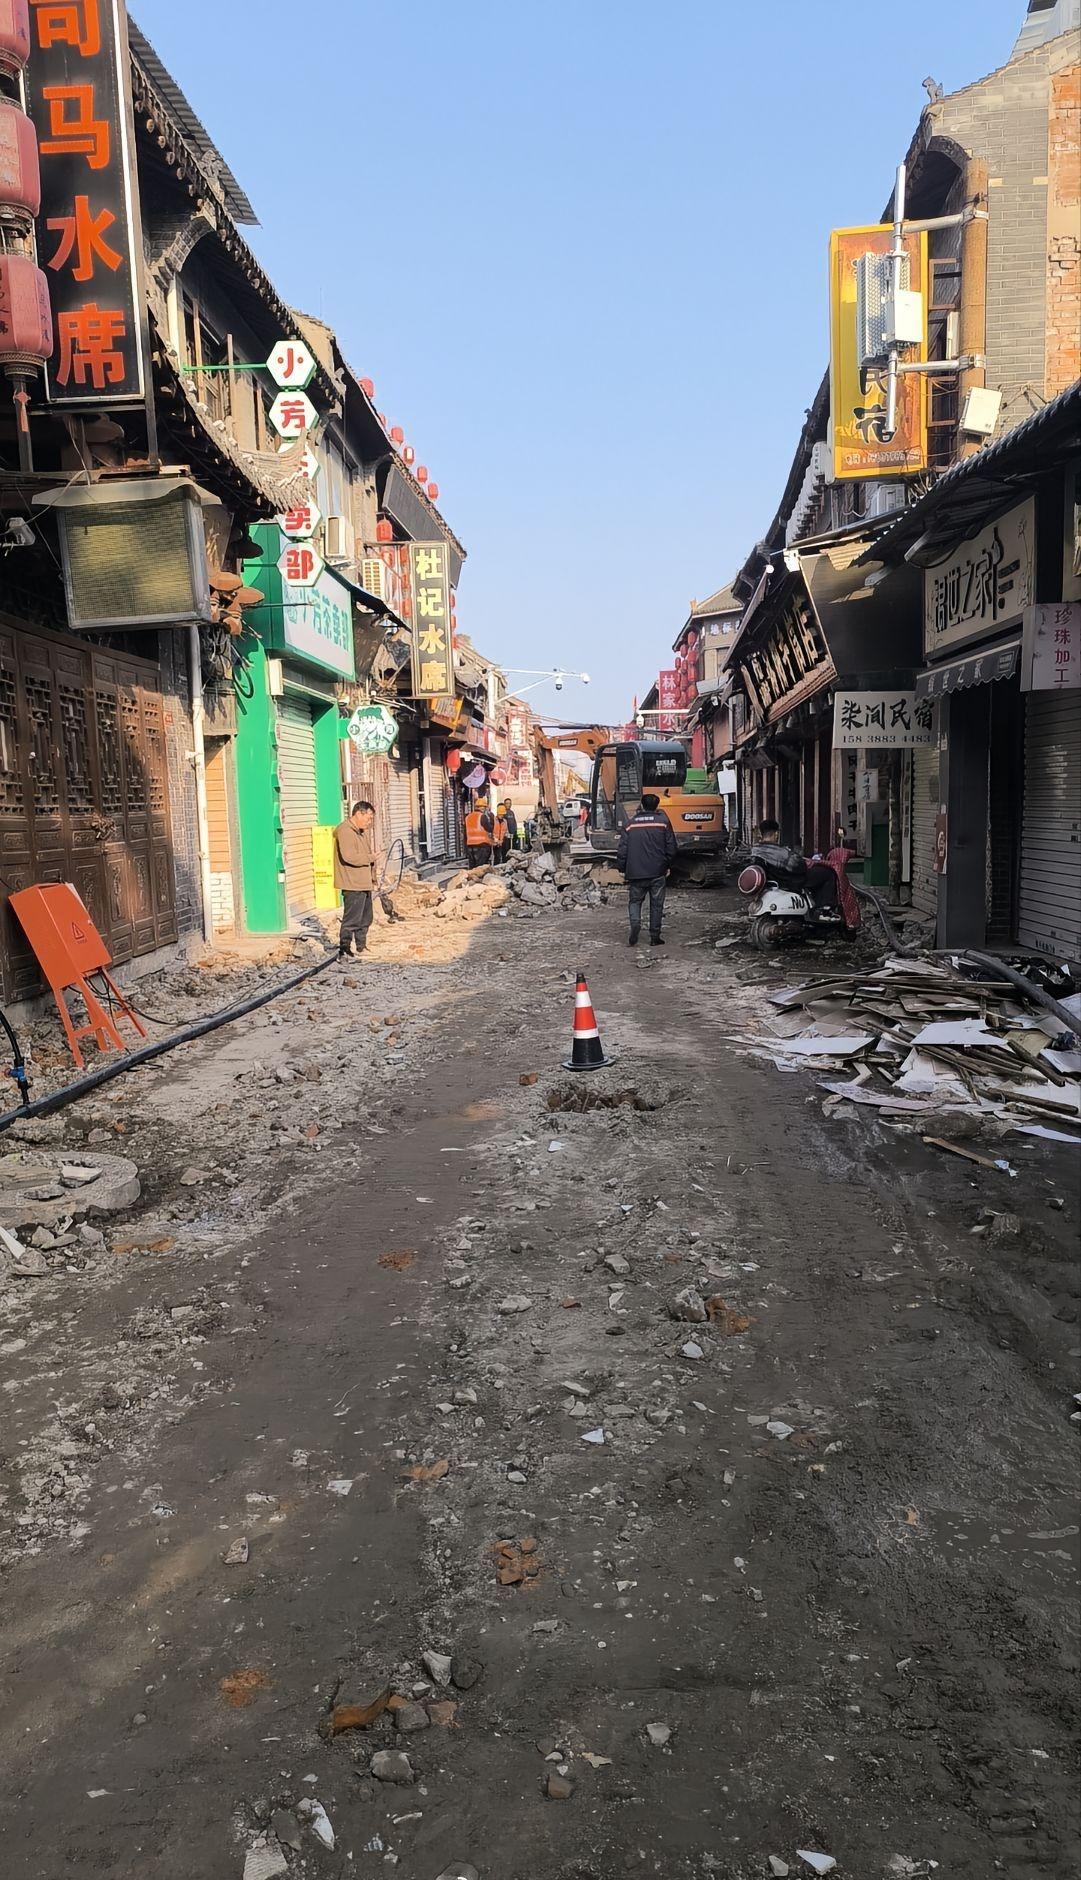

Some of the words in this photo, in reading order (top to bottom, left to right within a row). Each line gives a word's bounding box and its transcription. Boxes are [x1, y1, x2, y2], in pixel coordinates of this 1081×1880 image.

[28, 0, 125, 389] 司马水席
[276, 347, 315, 581] 小芳卖部
[415, 548, 447, 692] 杜记水席
[1053, 606, 1073, 683] 珍珠加工
[662, 674, 677, 732] 林家水
[843, 735, 862, 744] 158
[684, 812, 713, 821] DOOSAN
